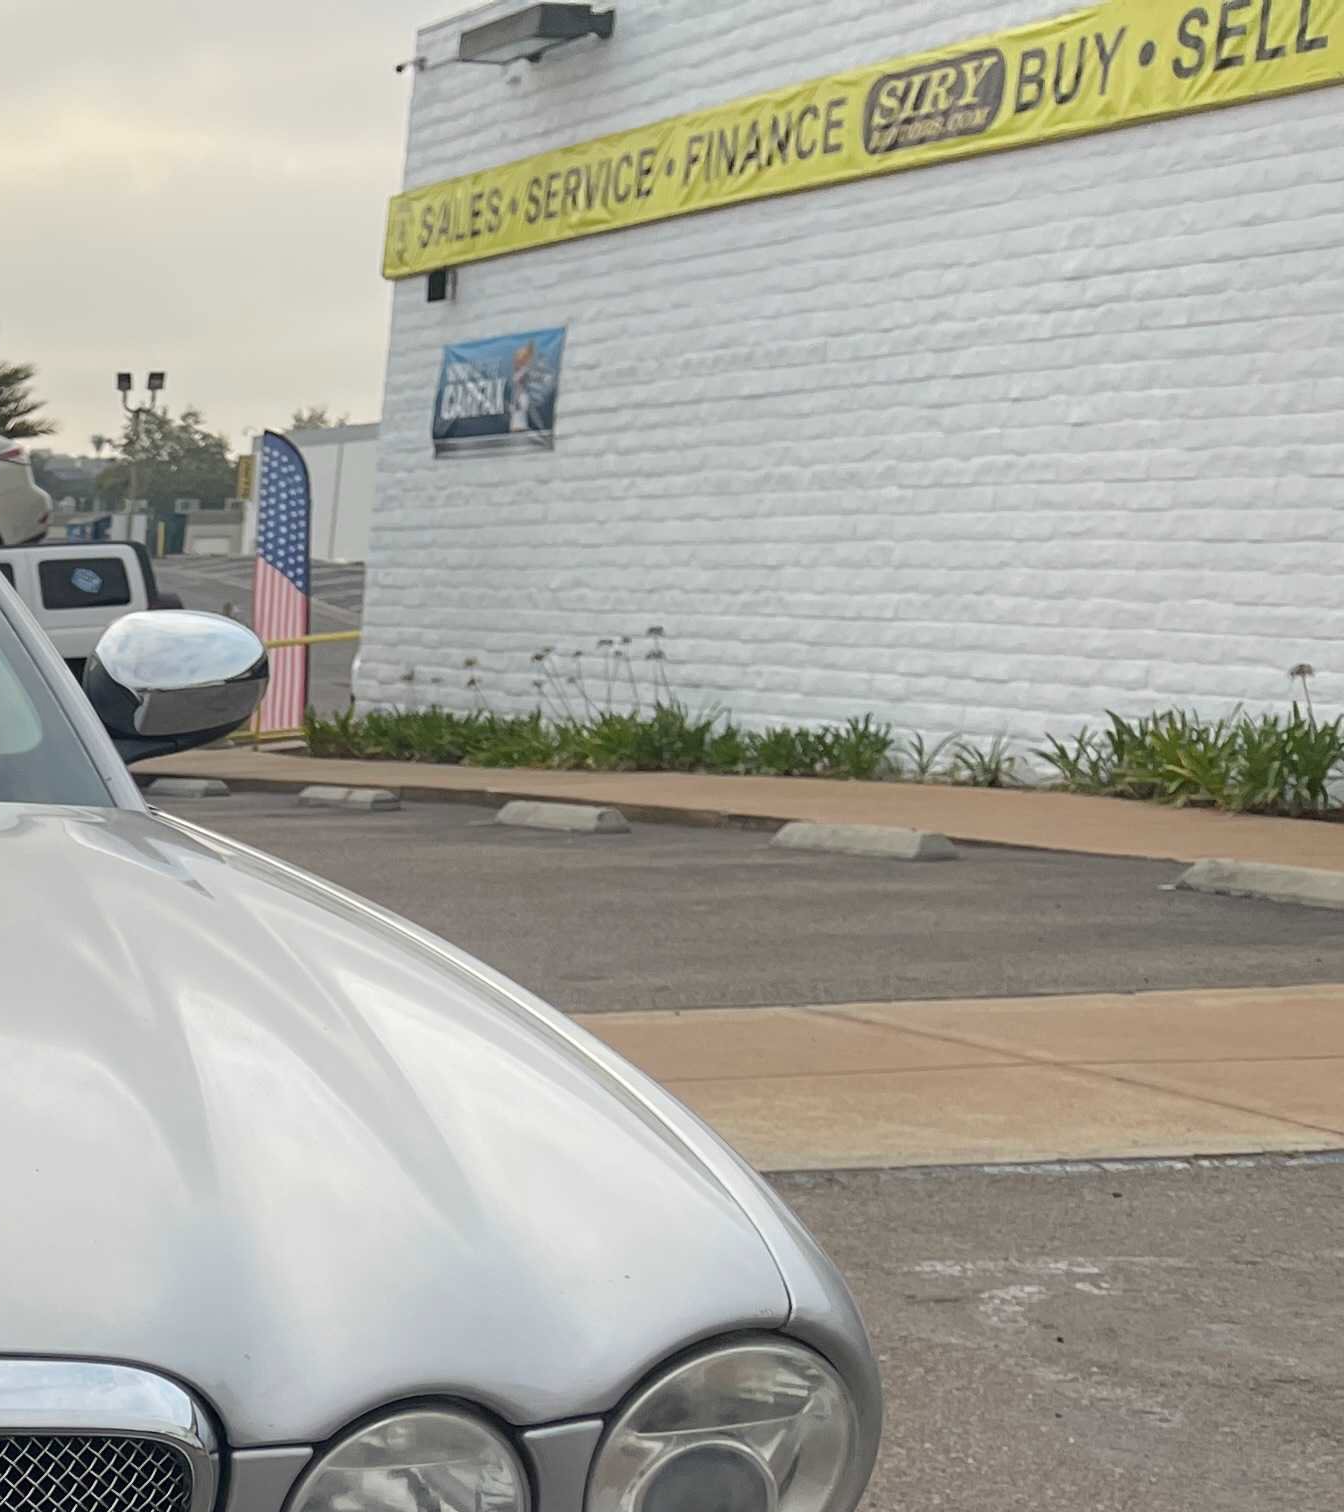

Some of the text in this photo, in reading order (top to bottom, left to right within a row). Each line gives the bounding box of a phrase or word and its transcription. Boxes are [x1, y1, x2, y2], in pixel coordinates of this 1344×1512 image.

[872, 56, 999, 127] SIRY
[1015, 0, 1329, 113] BUY SELL
[418, 98, 847, 248] SALES SERVICE FINANCE
